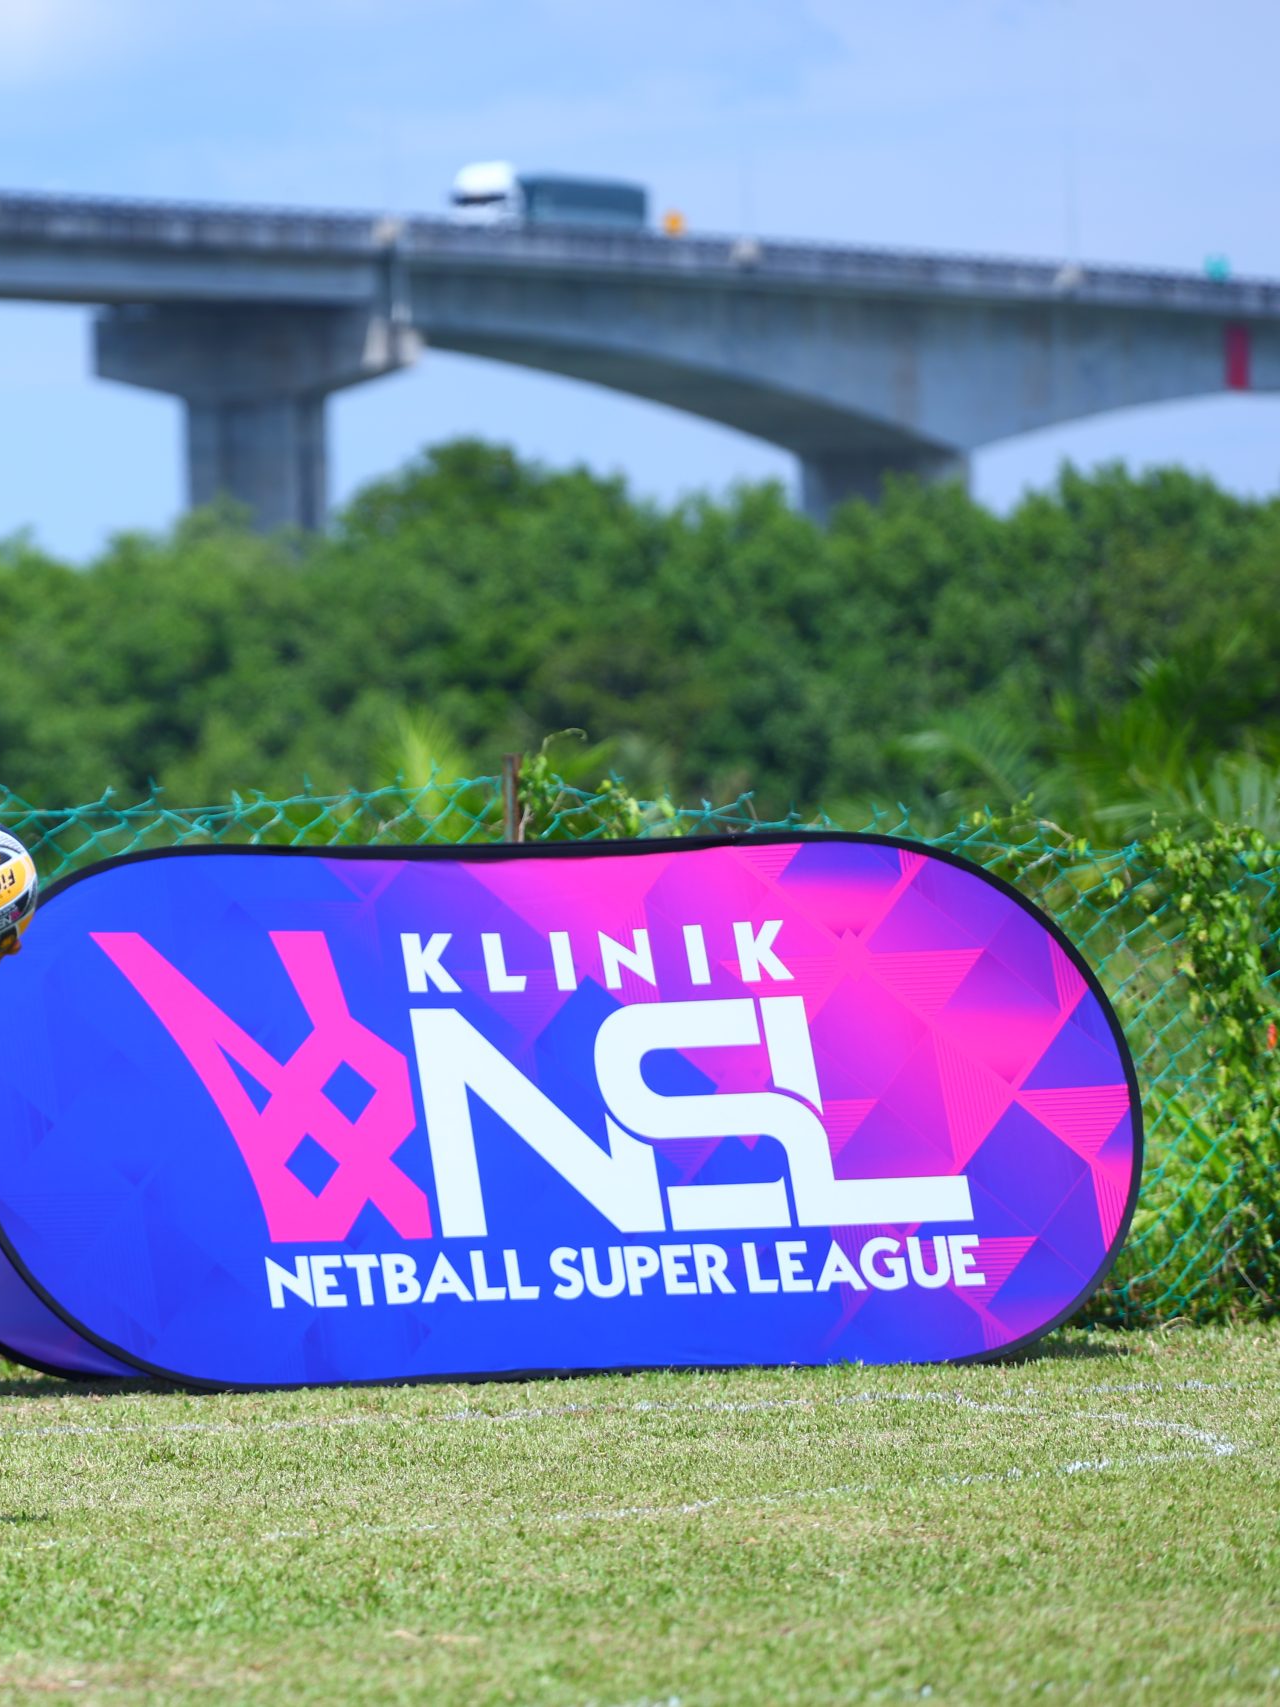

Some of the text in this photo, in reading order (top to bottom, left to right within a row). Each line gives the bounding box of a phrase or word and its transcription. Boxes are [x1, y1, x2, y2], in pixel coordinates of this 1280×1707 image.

[400, 920, 794, 993] KLINIK
[408, 995, 974, 1239] NSL
[264, 1234, 987, 1309] NETBALL SUPER LEAGUE
